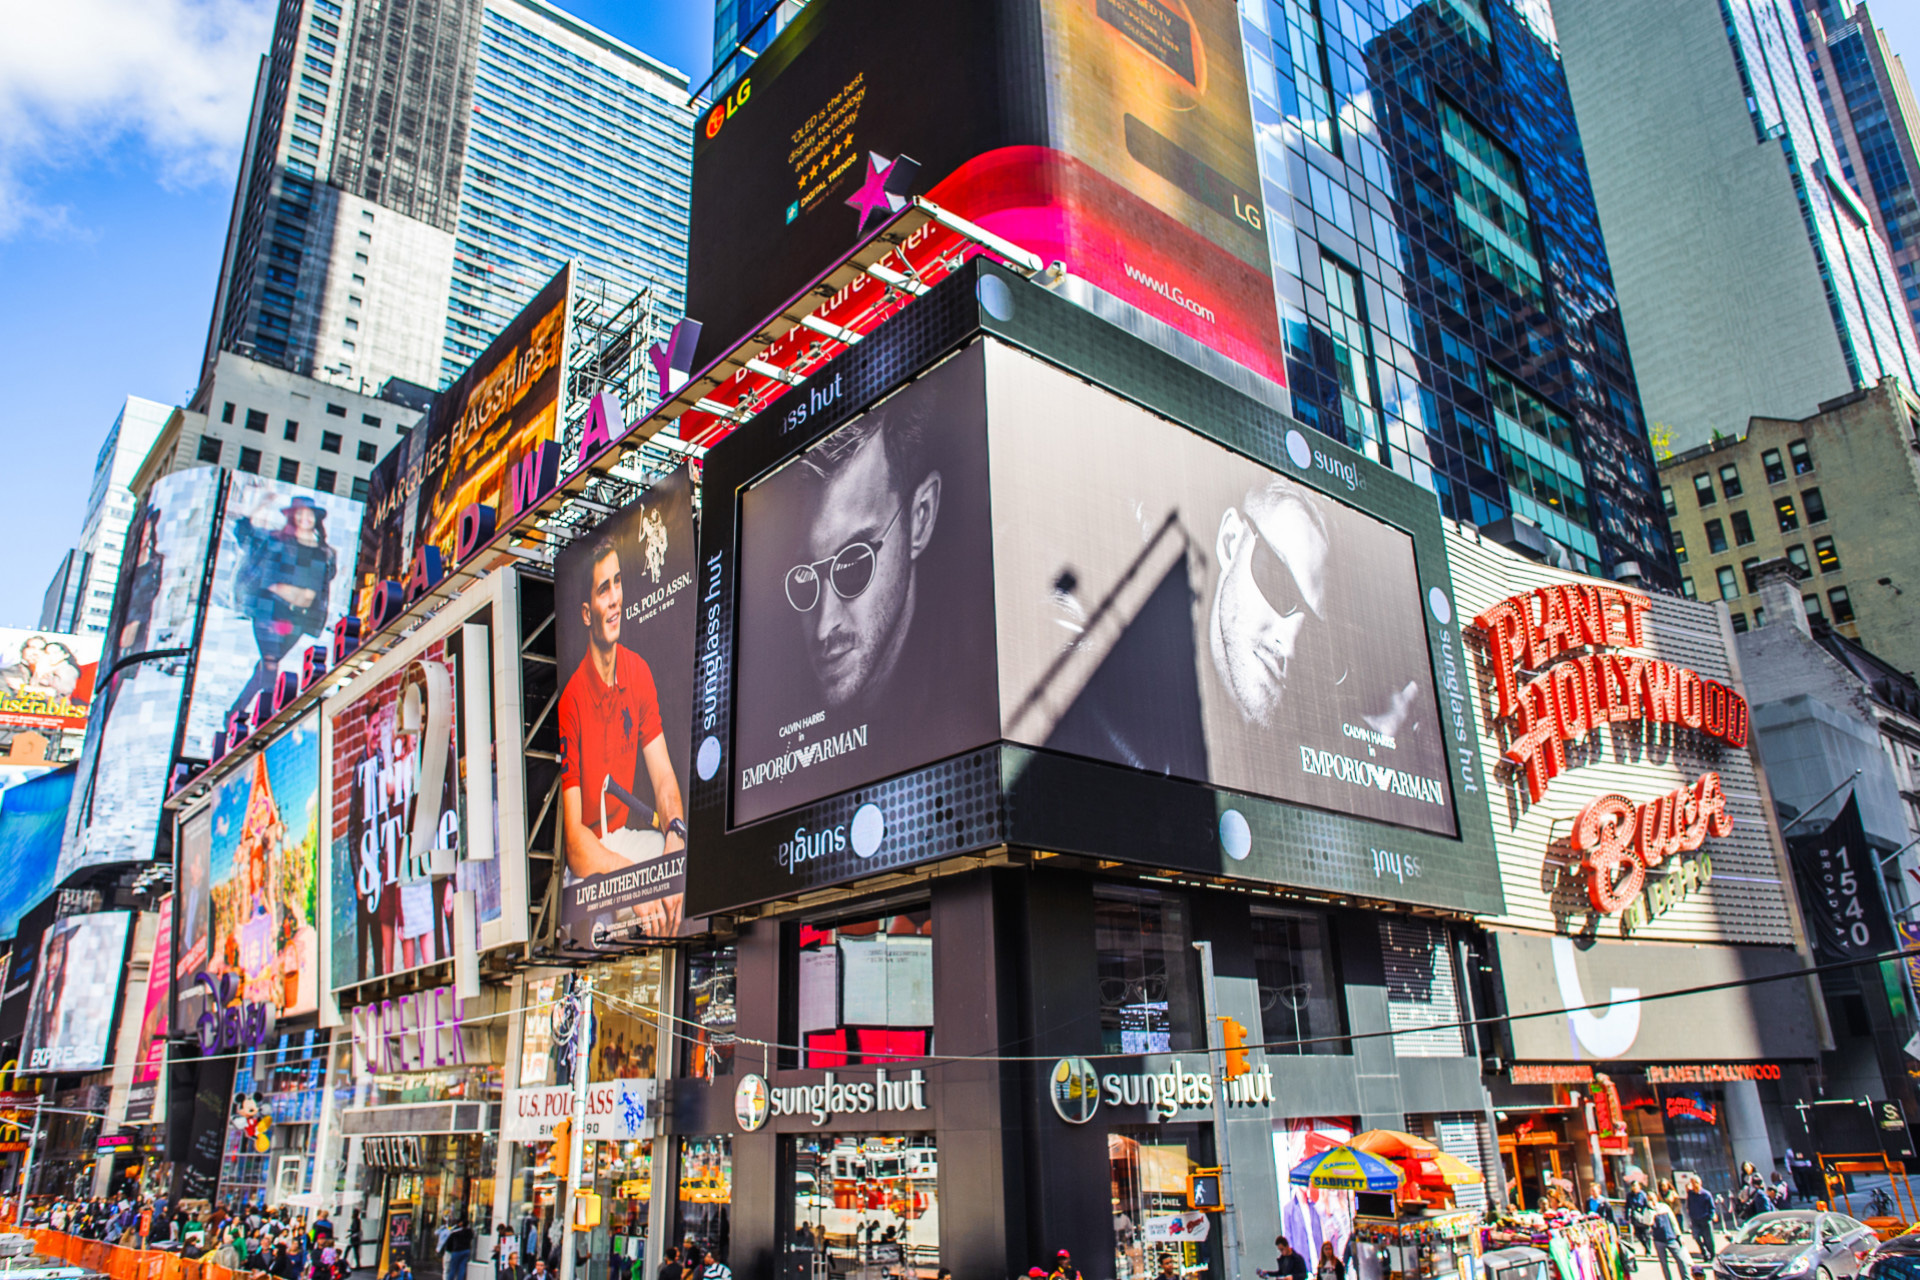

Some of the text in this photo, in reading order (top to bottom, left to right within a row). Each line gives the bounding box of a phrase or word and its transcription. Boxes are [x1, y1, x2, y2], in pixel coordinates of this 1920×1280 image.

[727, 78, 751, 119] LG
[818, 108, 826, 120] is
[827, 93, 842, 112] the
[844, 72, 863, 96] best
[788, 86, 866, 164] display technology
[795, 134, 831, 173] available
[800, 180, 827, 208] DIGITAL
[828, 152, 858, 183] TRENDS
[1233, 194, 1261, 231] LG
[1123, 262, 1216, 325] www.LG.com
[810, 372, 843, 416] hut
[372, 433, 447, 531] MARQUEE
[450, 336, 547, 455] FLAGSHIPS
[300, 317, 703, 694] BROADWAY
[625, 571, 692, 621] U.S. POLO ASSN.
[638, 608, 657, 624] SINCE
[702, 549, 722, 731] sunglass hut
[1473, 582, 1653, 718] PLANET
[16, 683, 45, 701] Les
[1439, 628, 1479, 794] sunglass hut
[778, 710, 826, 738] CALVIN HARRIS
[798, 732, 805, 742] in
[1342, 722, 1397, 751] CALVIN HARRIS
[1505, 652, 1750, 805] HOLLYWOOD
[741, 723, 868, 790] EMPORIO ARMANI
[1367, 743, 1377, 758] in
[1299, 745, 1445, 807] EMPORIO ARMANI
[576, 857, 686, 906] LIVE AUTHENTICALLY
[1819, 849, 1850, 948] BROADWAY
[1835, 845, 1870, 946] 1540
[351, 983, 466, 1078] FOREVER
[29, 1044, 100, 1069] EXPRESS
[1648, 1064, 1781, 1083] PLANET HOLLYWOOD
[518, 1093, 541, 1117] U.S.
[770, 1068, 927, 1127] sunglass hut
[1102, 1058, 1227, 1118] sunglas
[1151, 1198, 1182, 1207] CHANEL
[1313, 1175, 1366, 1188] SABRETT
